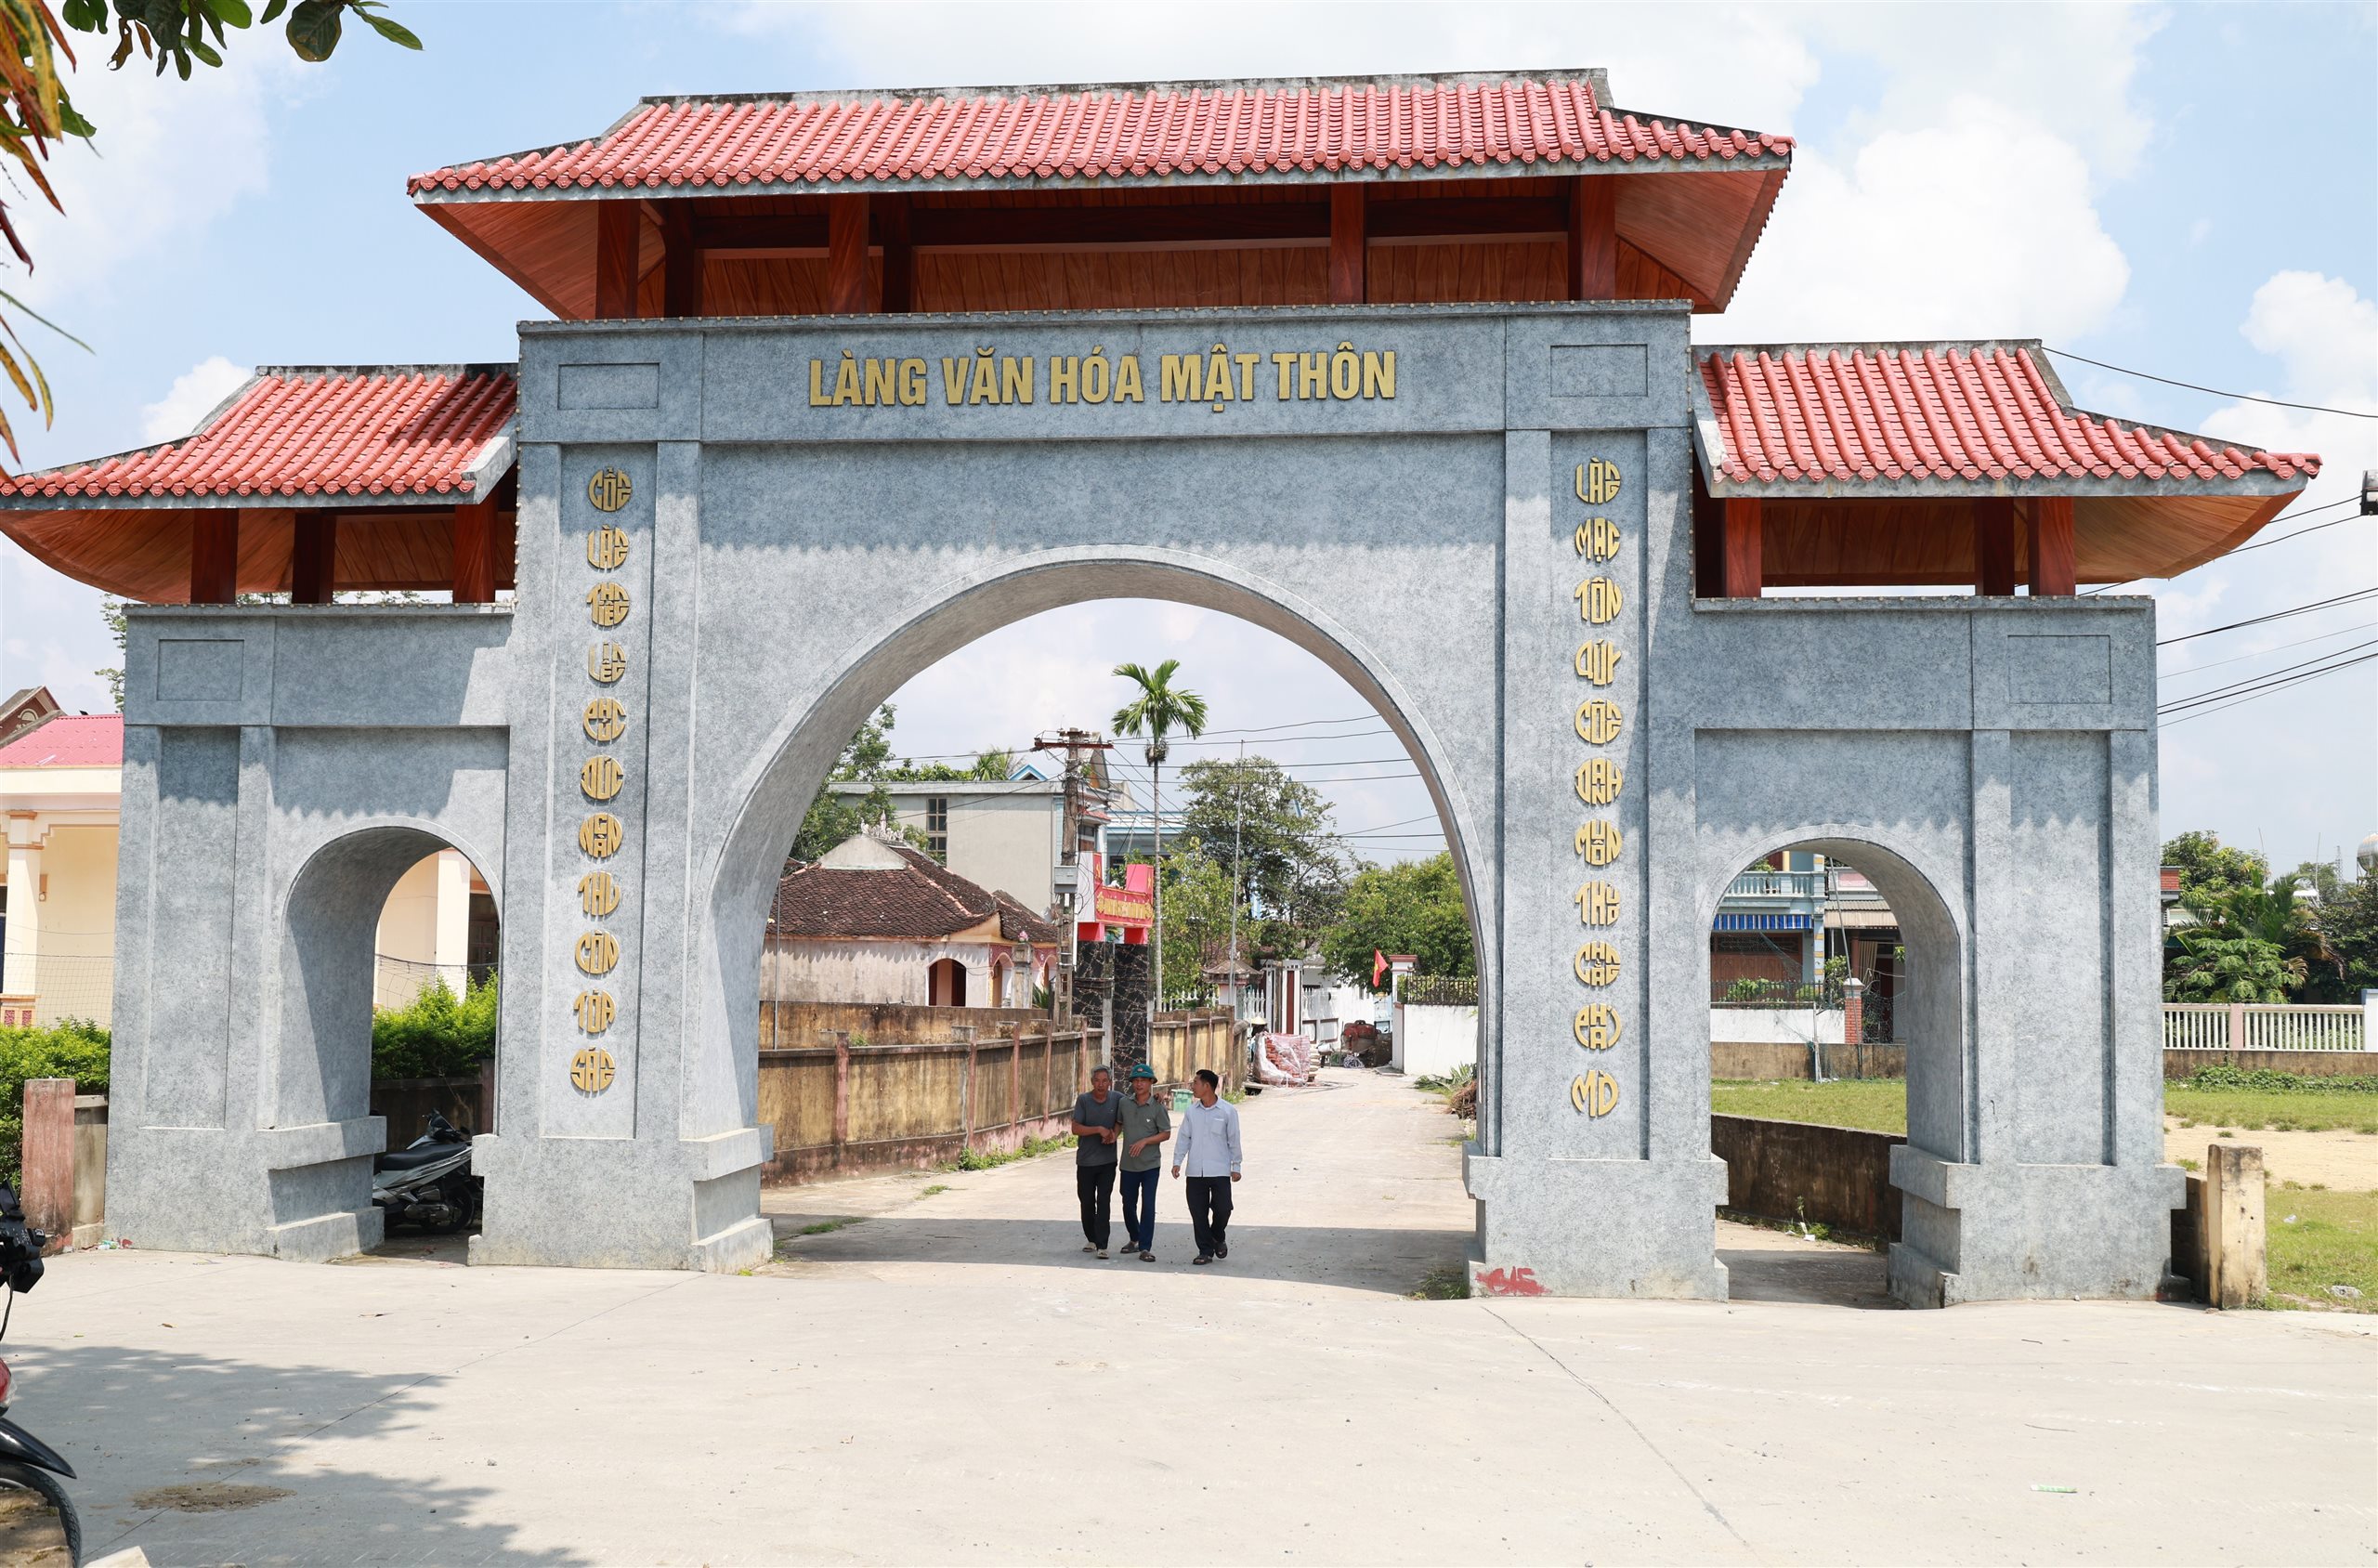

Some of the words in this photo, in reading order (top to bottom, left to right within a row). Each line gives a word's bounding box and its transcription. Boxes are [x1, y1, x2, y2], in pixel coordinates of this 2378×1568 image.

[809, 350, 927, 407] LÀNG
[941, 346, 1035, 405] VĂN
[1050, 345, 1144, 404] HÓA
[1160, 343, 1261, 412] MẬT
[1271, 341, 1396, 400] THÔN
[1574, 457, 1621, 504] LÀNG
[1574, 578, 1623, 624] TÔN
